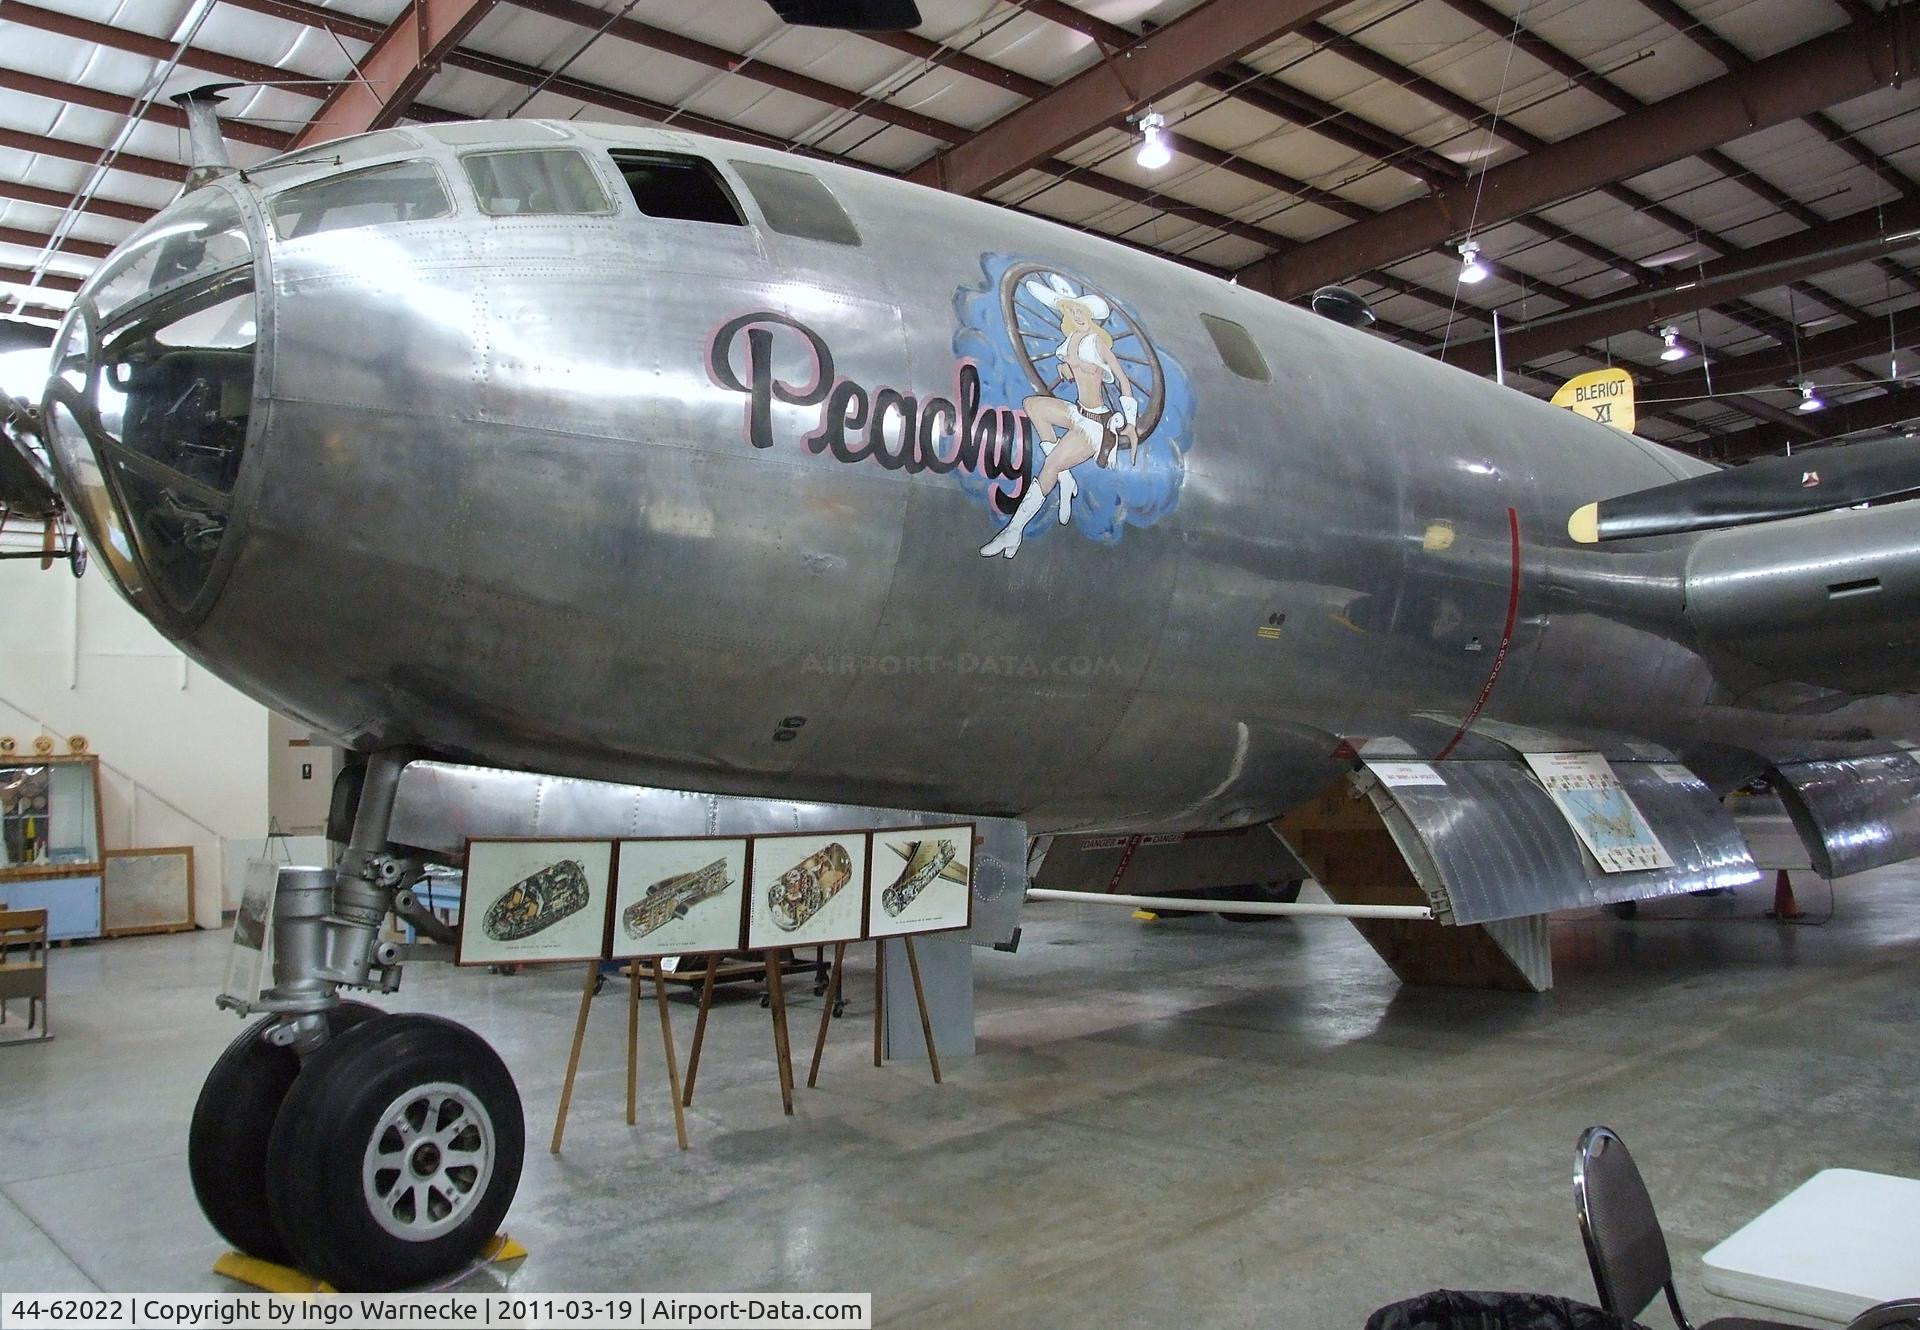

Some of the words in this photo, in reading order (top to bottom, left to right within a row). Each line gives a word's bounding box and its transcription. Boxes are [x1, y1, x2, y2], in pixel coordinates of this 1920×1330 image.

[1575, 379, 1626, 403] BLERIOT
[706, 312, 1034, 516] Peachy
[1592, 403, 1613, 424] XI
[1460, 637, 1509, 732] PROPELLER
[1083, 838, 1116, 850] DANGER
[1152, 832, 1185, 844] DANGER
